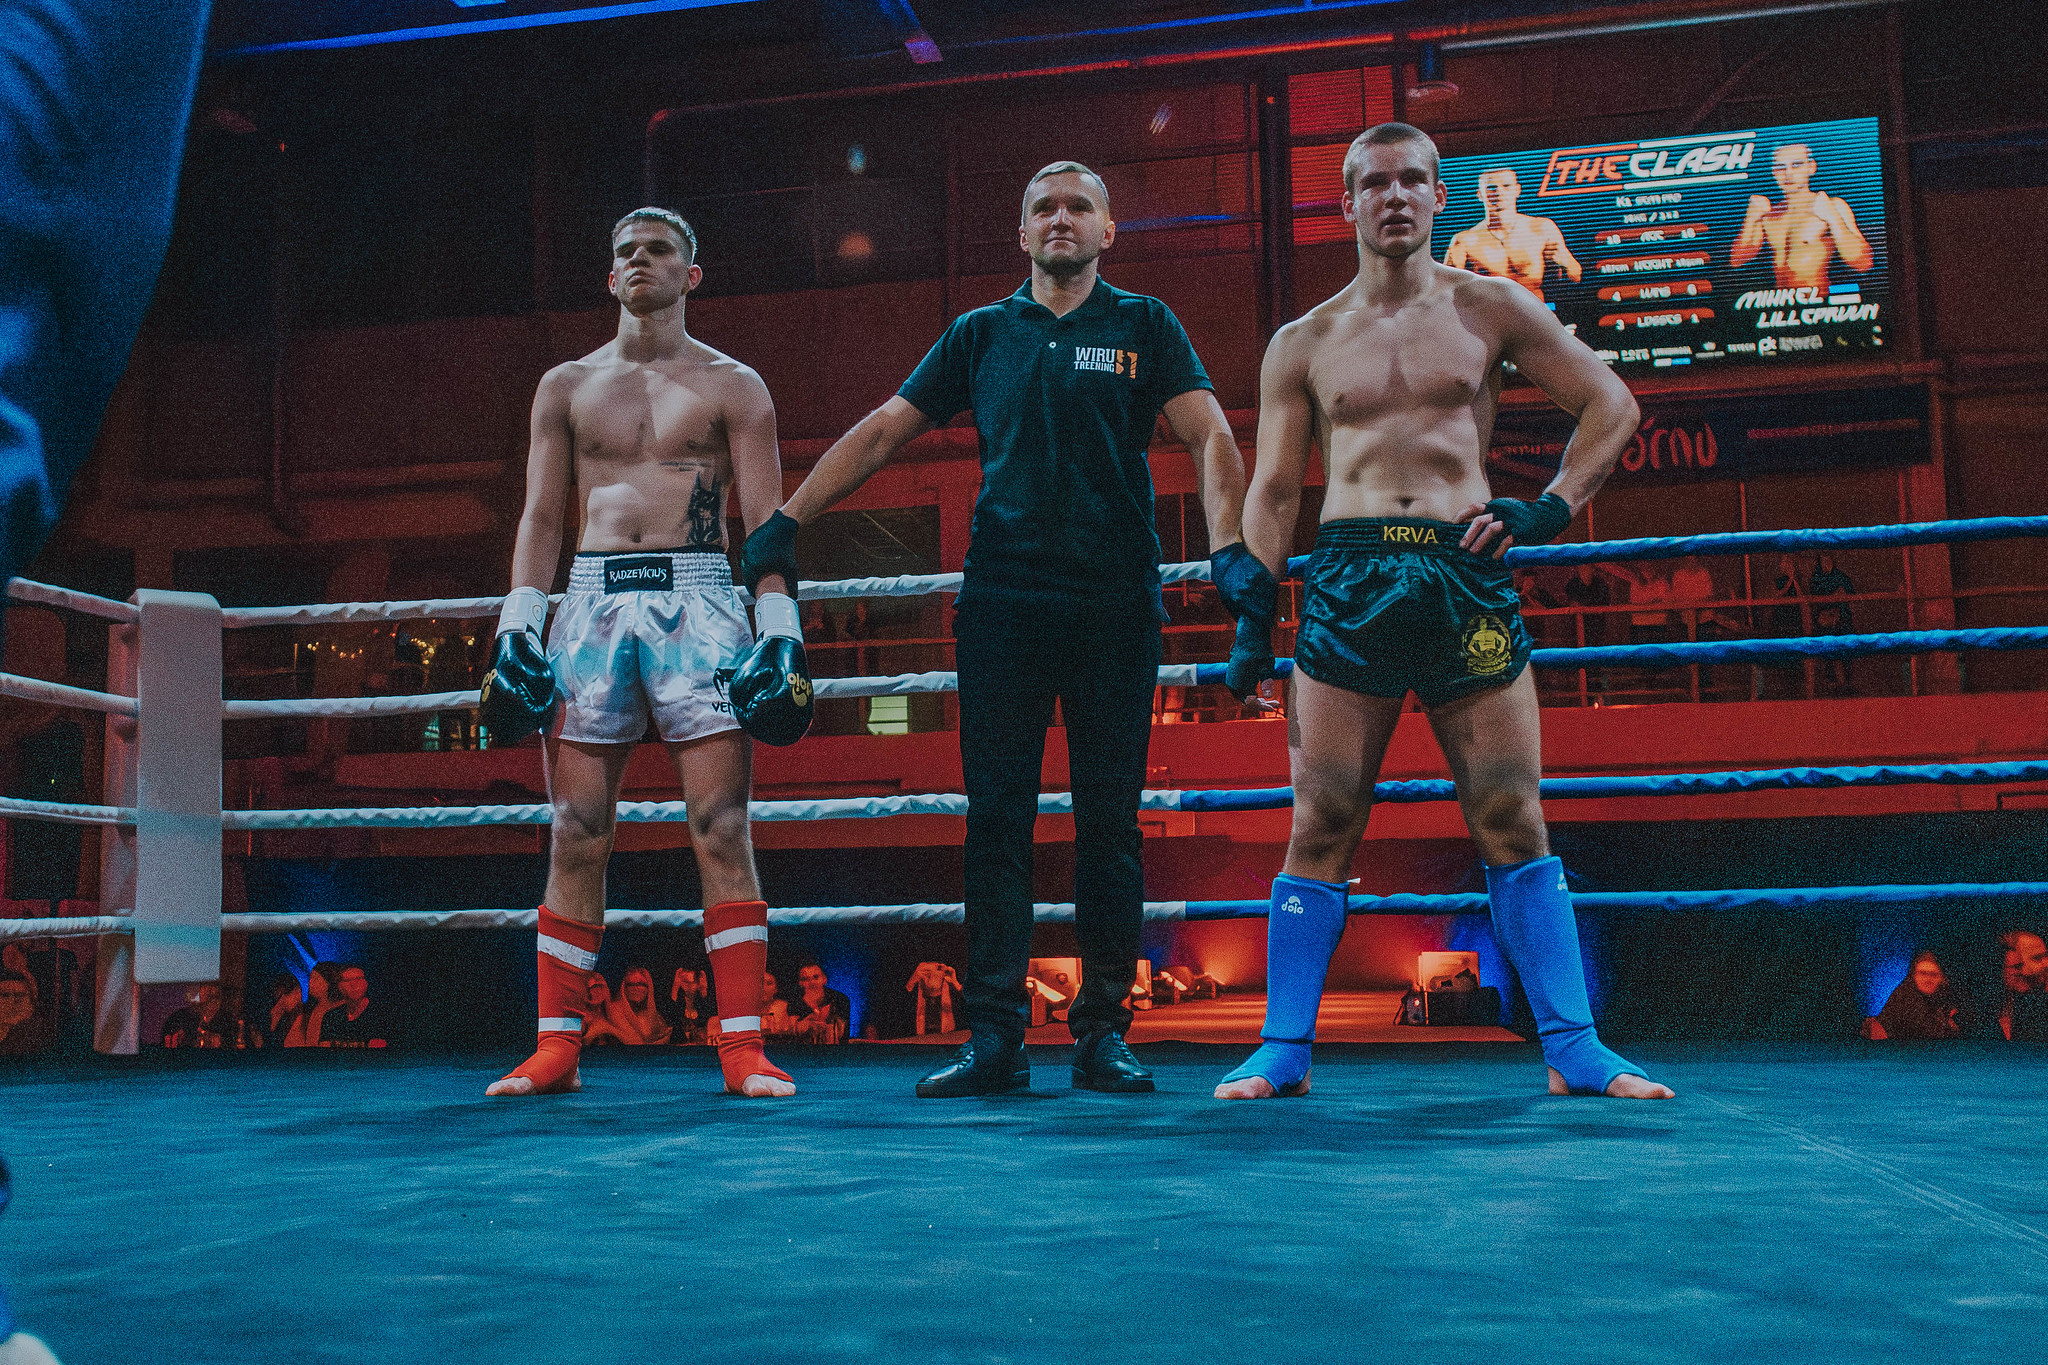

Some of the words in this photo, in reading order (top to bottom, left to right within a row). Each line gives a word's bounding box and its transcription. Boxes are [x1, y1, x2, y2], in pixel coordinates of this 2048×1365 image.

[1556, 155, 1629, 185] THE
[1630, 143, 1755, 177] CLASH
[1633, 258, 1673, 271] HEIGHT
[1640, 286, 1671, 299] WINS
[1637, 313, 1682, 328] LOSSES
[1075, 346, 1116, 363] WIRU
[1073, 360, 1115, 373] TREENING
[1383, 525, 1439, 544] KRVA
[609, 565, 667, 583] RADZEVICIUS
[1281, 901, 1304, 914] dojo
